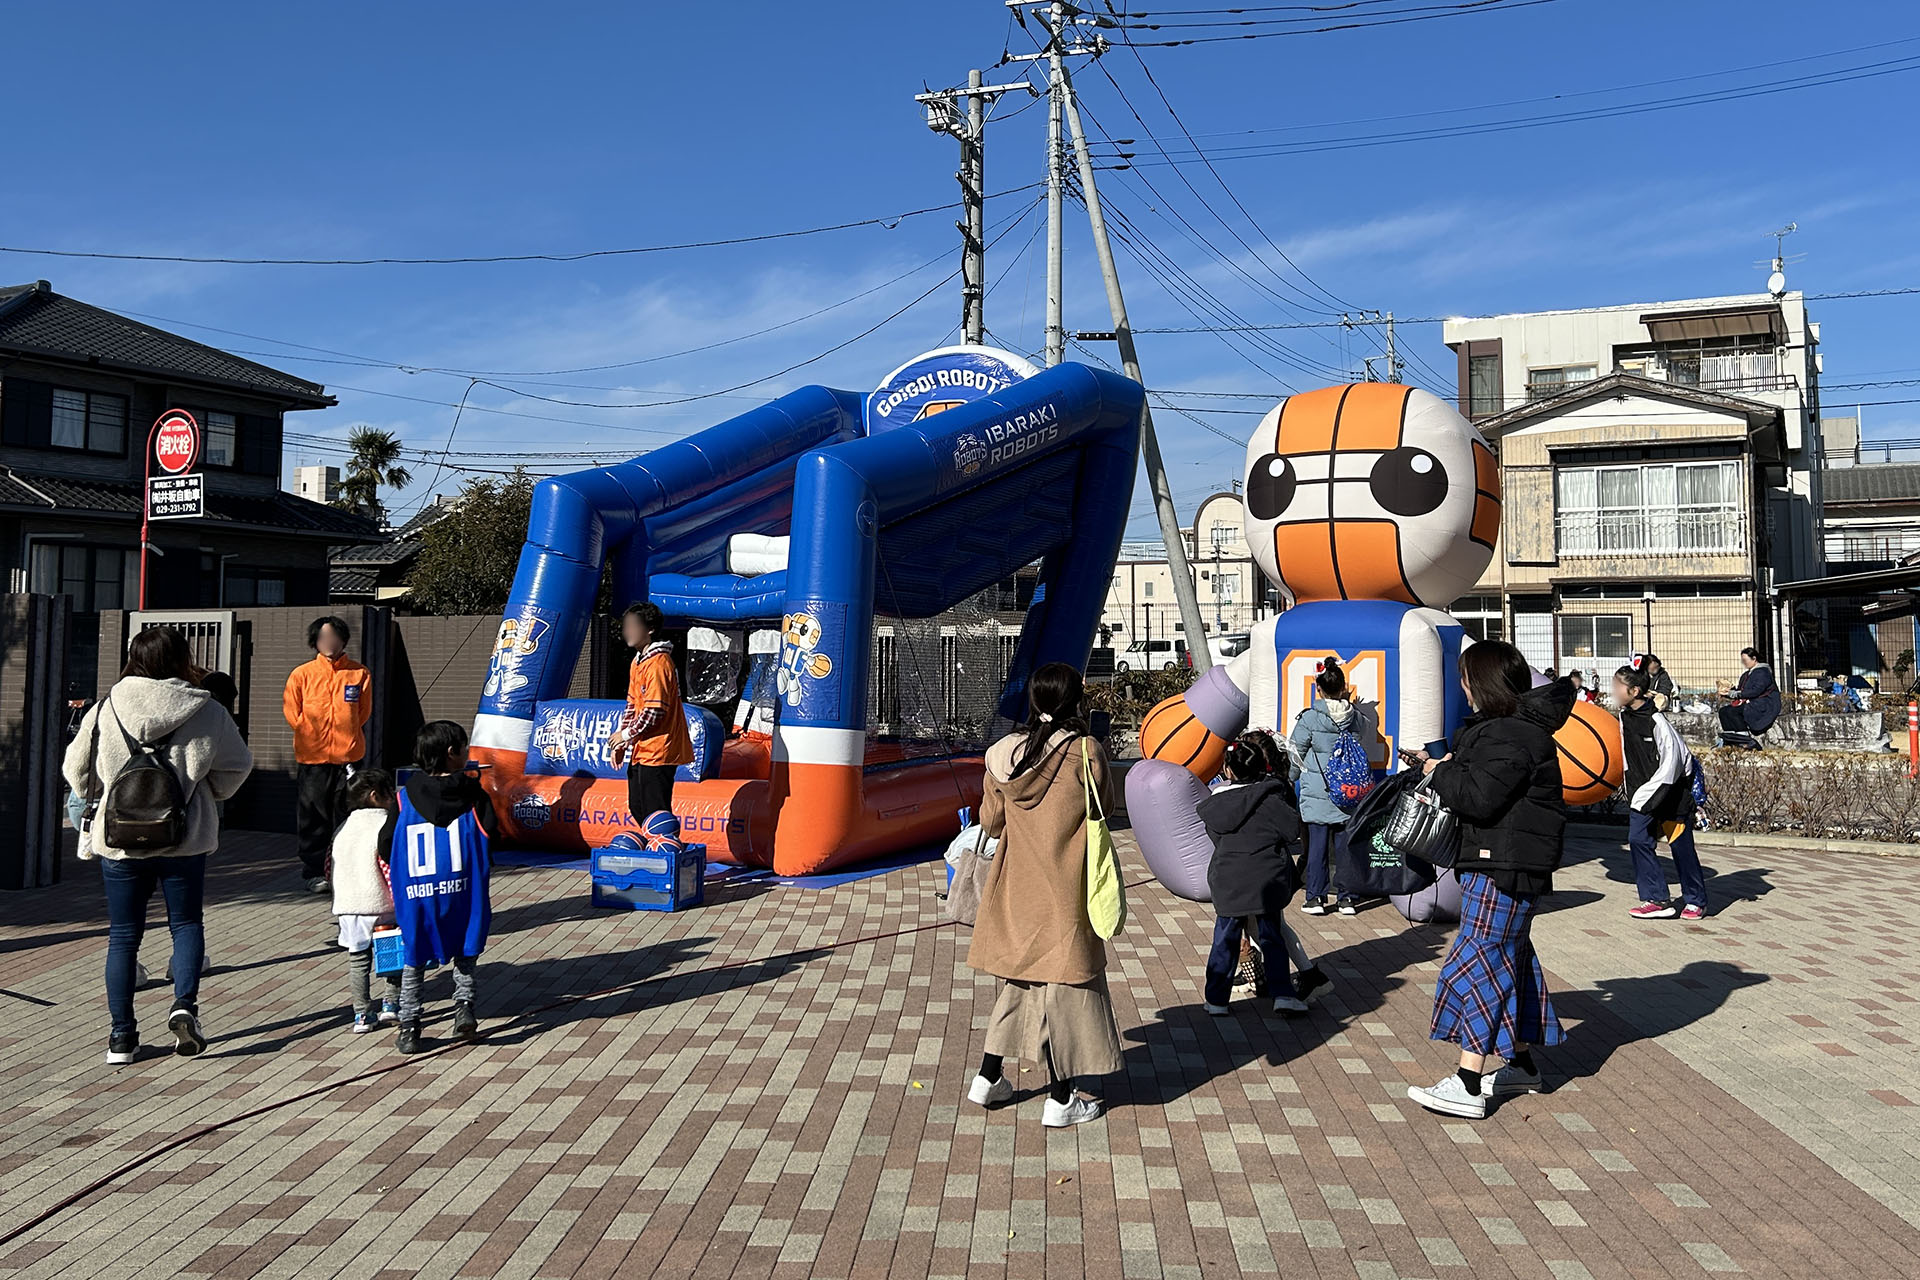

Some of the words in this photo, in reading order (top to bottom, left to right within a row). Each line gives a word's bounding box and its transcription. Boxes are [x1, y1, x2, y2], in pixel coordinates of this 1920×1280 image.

[985, 403, 1057, 445] IBARAKI
[160, 434, 190, 455] 消火栓
[953, 440, 988, 470] ROBOTS
[990, 423, 1059, 465] ROBOTS
[156, 502, 196, 514] 029-231-1792
[513, 802, 551, 821] ROBOTS
[557, 808, 637, 827] IBARAK
[406, 818, 463, 878] 01
